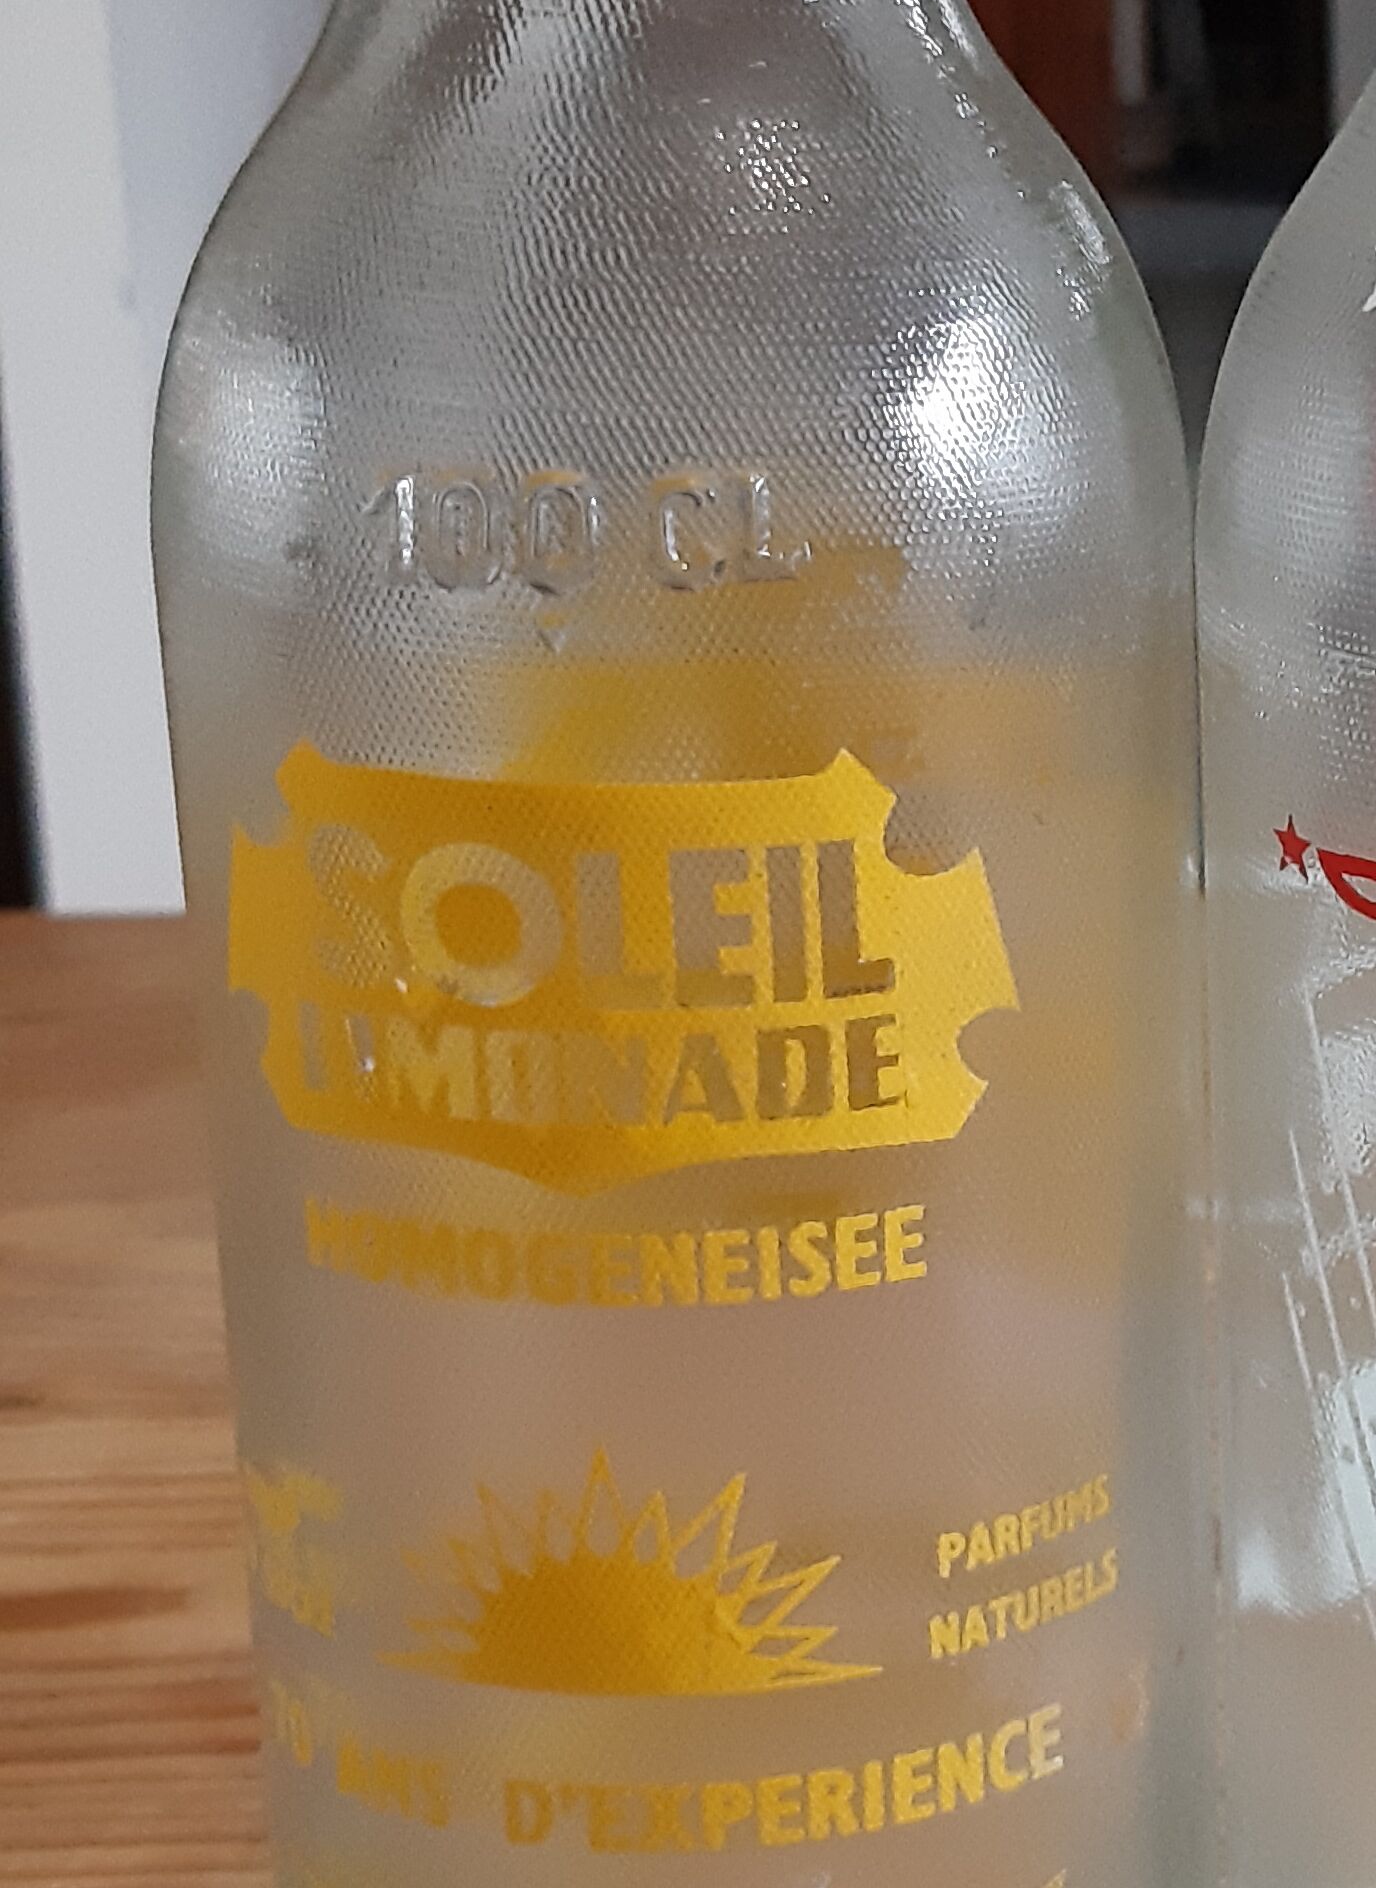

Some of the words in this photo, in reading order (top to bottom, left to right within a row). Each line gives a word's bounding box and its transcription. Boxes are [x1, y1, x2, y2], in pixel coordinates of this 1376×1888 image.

[361, 472, 604, 595] 100
[652, 472, 812, 594] CL
[307, 822, 897, 1010] SOLEIL
[303, 1000, 902, 1127] LIMONADE
[306, 1196, 928, 1308] HOMOGENEISEE
[936, 1473, 1112, 1579] PARFUMS
[928, 1545, 1119, 1660] NATURELS
[504, 1701, 1065, 1856] D'EXPERIENCE
